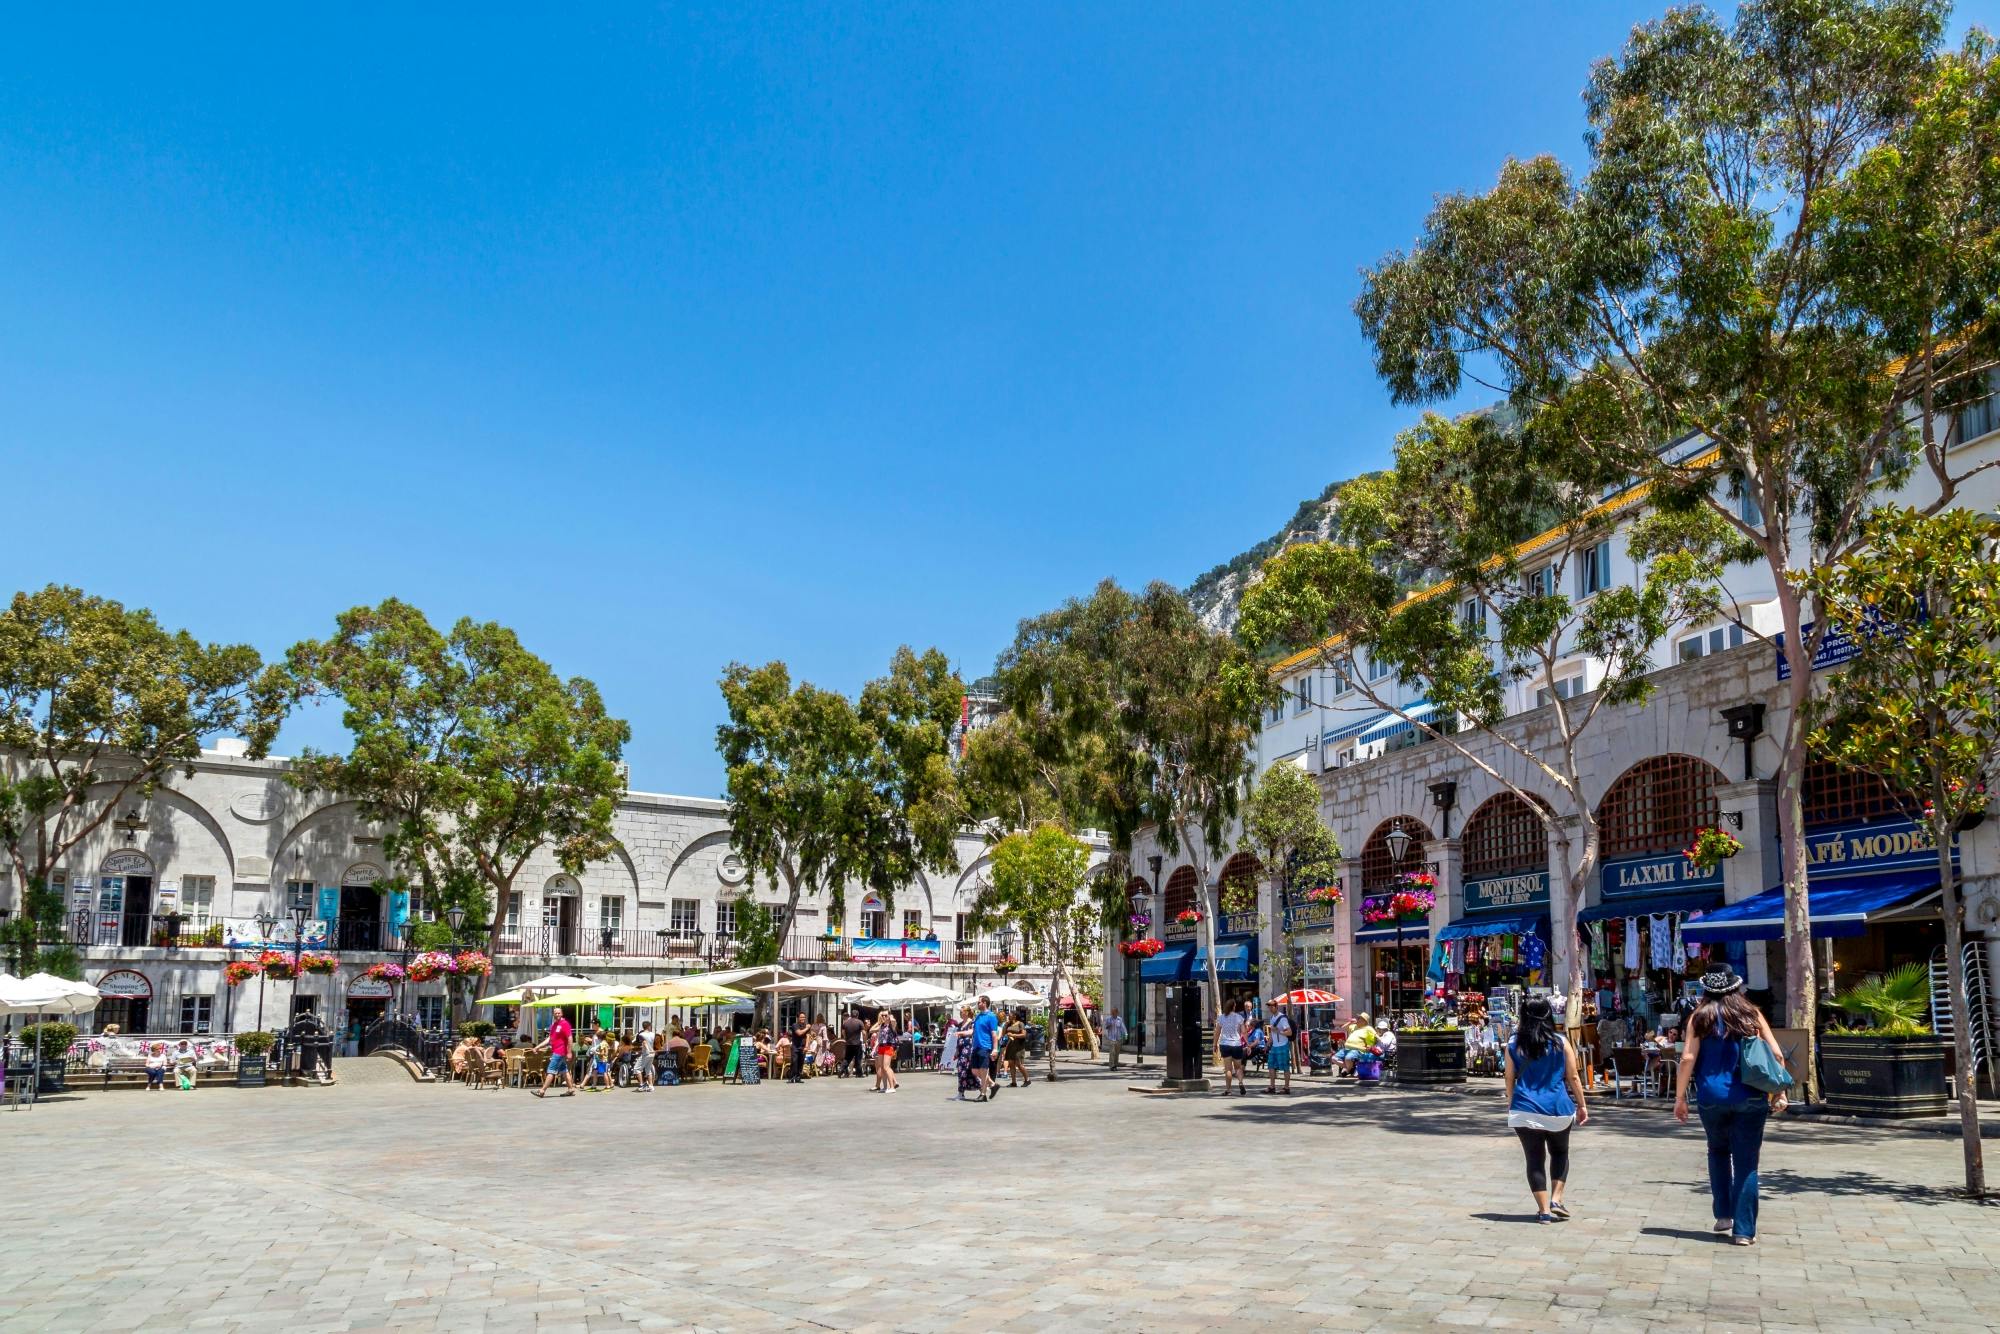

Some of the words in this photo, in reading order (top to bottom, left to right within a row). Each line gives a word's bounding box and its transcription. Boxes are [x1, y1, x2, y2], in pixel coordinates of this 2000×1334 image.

[1783, 832, 1846, 864] AFÉ
[1619, 863, 1676, 887] LAXMI
[1478, 875, 1544, 898] MONTESOL
[1491, 895, 1510, 905] GIFT
[1511, 893, 1531, 903] SHOP
[348, 975, 391, 994] CASETES
[657, 1059, 678, 1069] PAELLA
